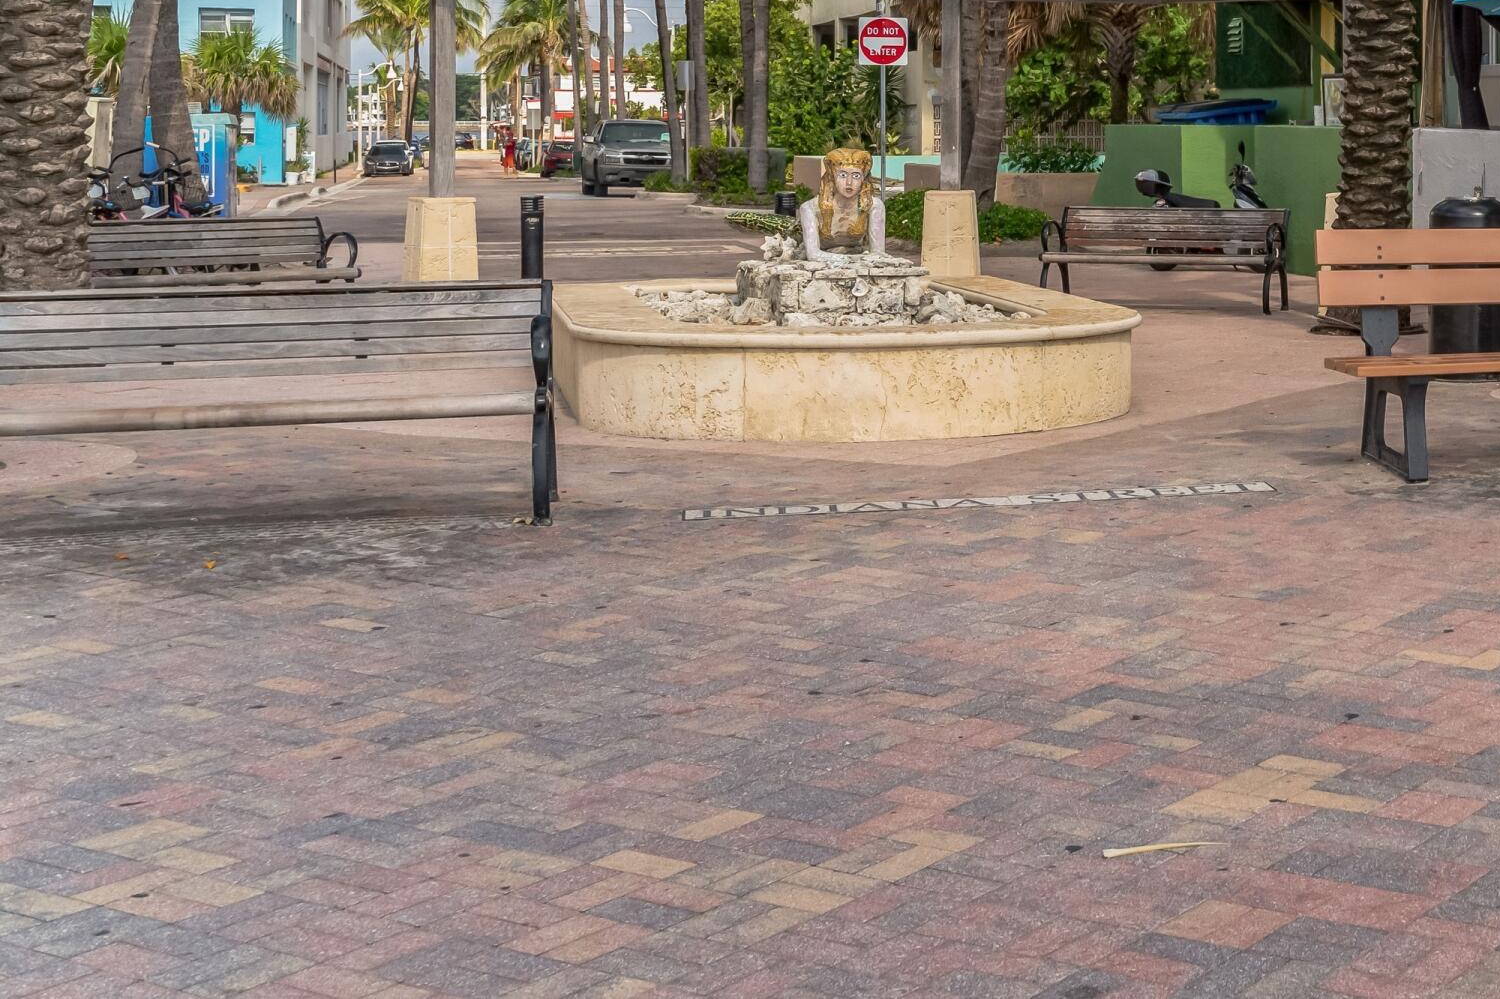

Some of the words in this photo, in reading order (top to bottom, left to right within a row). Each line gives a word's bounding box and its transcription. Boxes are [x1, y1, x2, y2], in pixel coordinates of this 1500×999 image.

[867, 27, 879, 35] DO
[882, 27, 900, 35] NOT
[869, 48, 897, 56] ENTER
[701, 498, 992, 519] INDIANA
[1027, 482, 1266, 505] STREET
